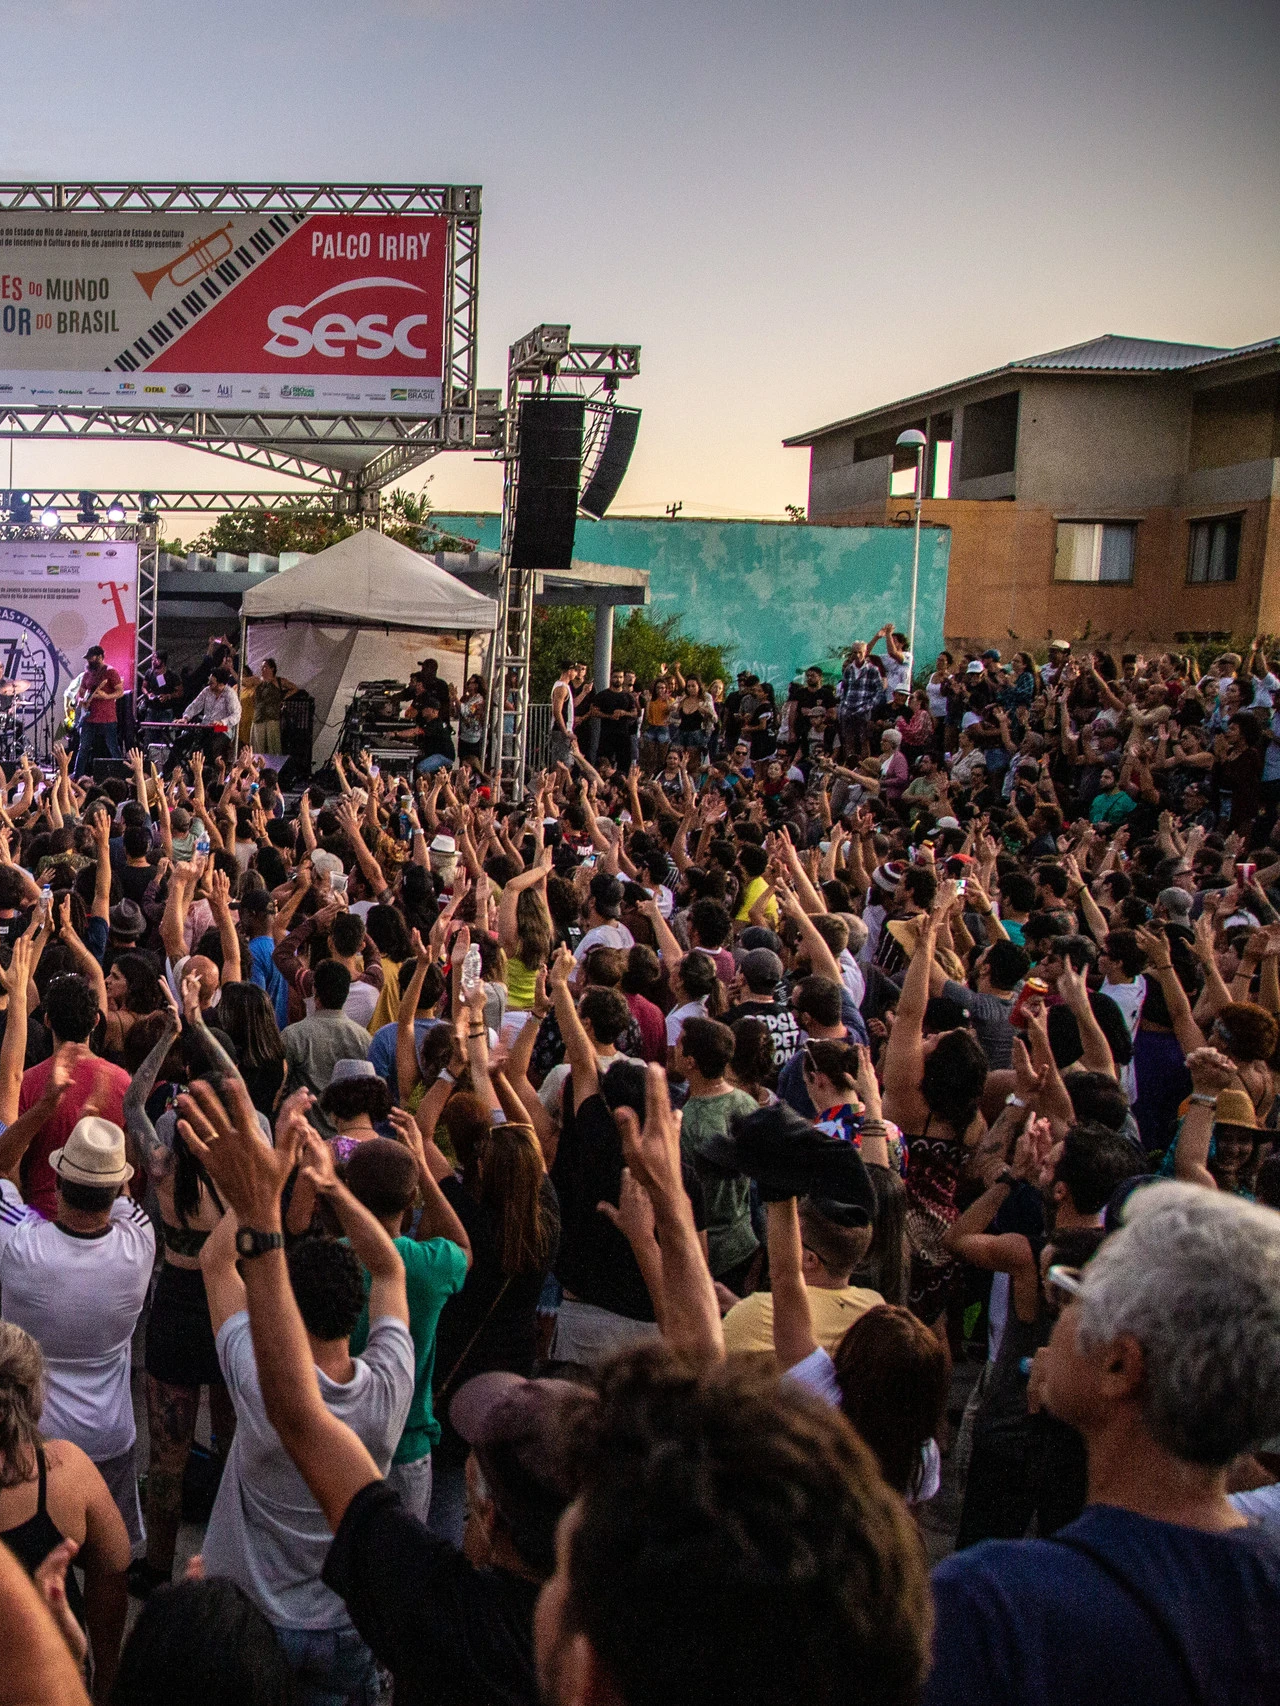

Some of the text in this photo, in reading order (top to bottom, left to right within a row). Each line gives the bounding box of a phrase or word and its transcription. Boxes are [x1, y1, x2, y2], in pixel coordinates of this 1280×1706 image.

[5, 228, 13, 236] do
[14, 228, 35, 236] Estado
[35, 228, 43, 236] do
[44, 228, 54, 236] Rio
[55, 228, 63, 236] de
[64, 228, 89, 238] Janeiro,
[90, 228, 122, 237] Secretaria
[122, 229, 131, 237] de
[131, 229, 152, 237] Estado
[153, 229, 161, 237] de
[161, 229, 185, 238] Cultura
[13, 238, 42, 247] Incentivo
[48, 238, 71, 247] Cultura
[71, 239, 80, 247] do
[80, 239, 91, 247] Rio
[91, 239, 100, 247] de
[100, 239, 123, 248] Janeiro
[129, 239, 144, 248] SESC
[311, 231, 431, 261] PALCO IRIRY
[29, 281, 43, 297] DO
[46, 278, 109, 302] MUNDO
[36, 313, 52, 330] DO
[57, 309, 120, 335] BRASIL
[407, 392, 435, 400] BRASIL
[21, 616, 33, 627] RJ
